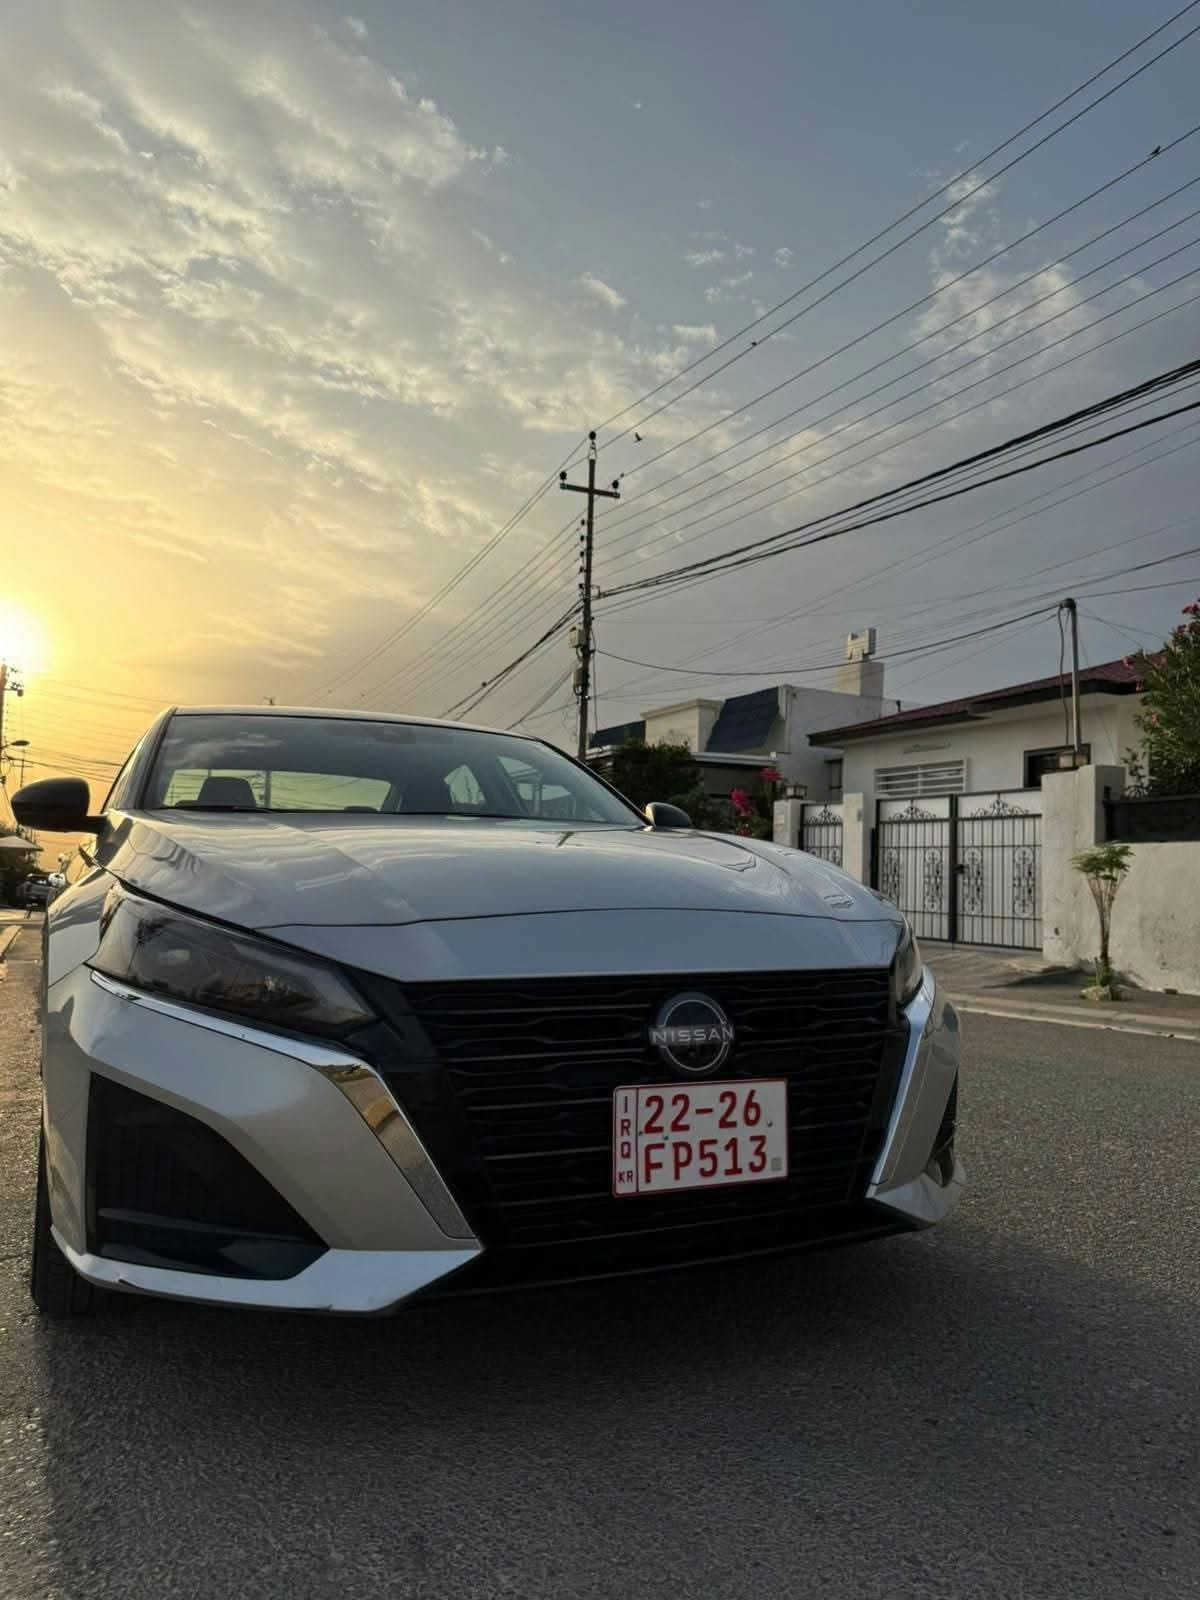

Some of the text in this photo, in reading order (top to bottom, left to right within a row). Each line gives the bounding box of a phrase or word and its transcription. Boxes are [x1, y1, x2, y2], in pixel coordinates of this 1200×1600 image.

[651, 1027, 735, 1044] NISSAN
[644, 1089, 761, 1134] 22-26
[644, 1135, 767, 1184] FP513
[618, 1170, 634, 1184] KR
